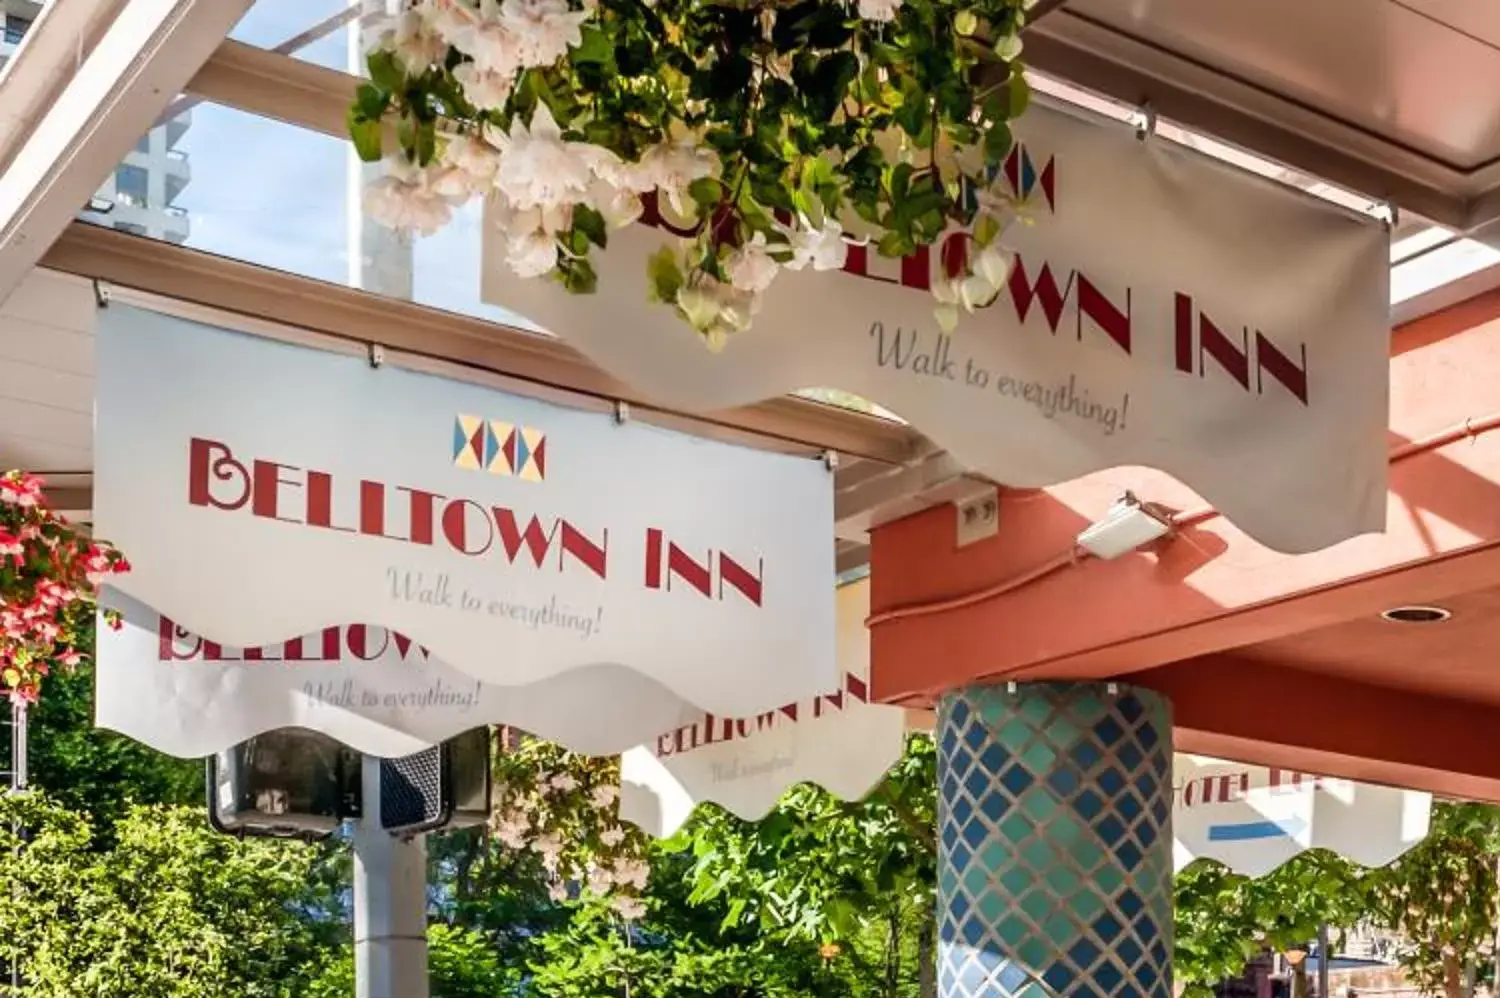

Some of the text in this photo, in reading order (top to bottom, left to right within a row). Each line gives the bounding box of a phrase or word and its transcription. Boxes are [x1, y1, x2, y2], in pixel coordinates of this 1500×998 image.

[869, 321, 1131, 436] Walk to everything!
[1174, 291, 1308, 407] INN
[189, 436, 763, 608] BELLTOWN INN
[385, 564, 604, 640] Walk to everything!
[302, 677, 484, 716] Walk to everything!
